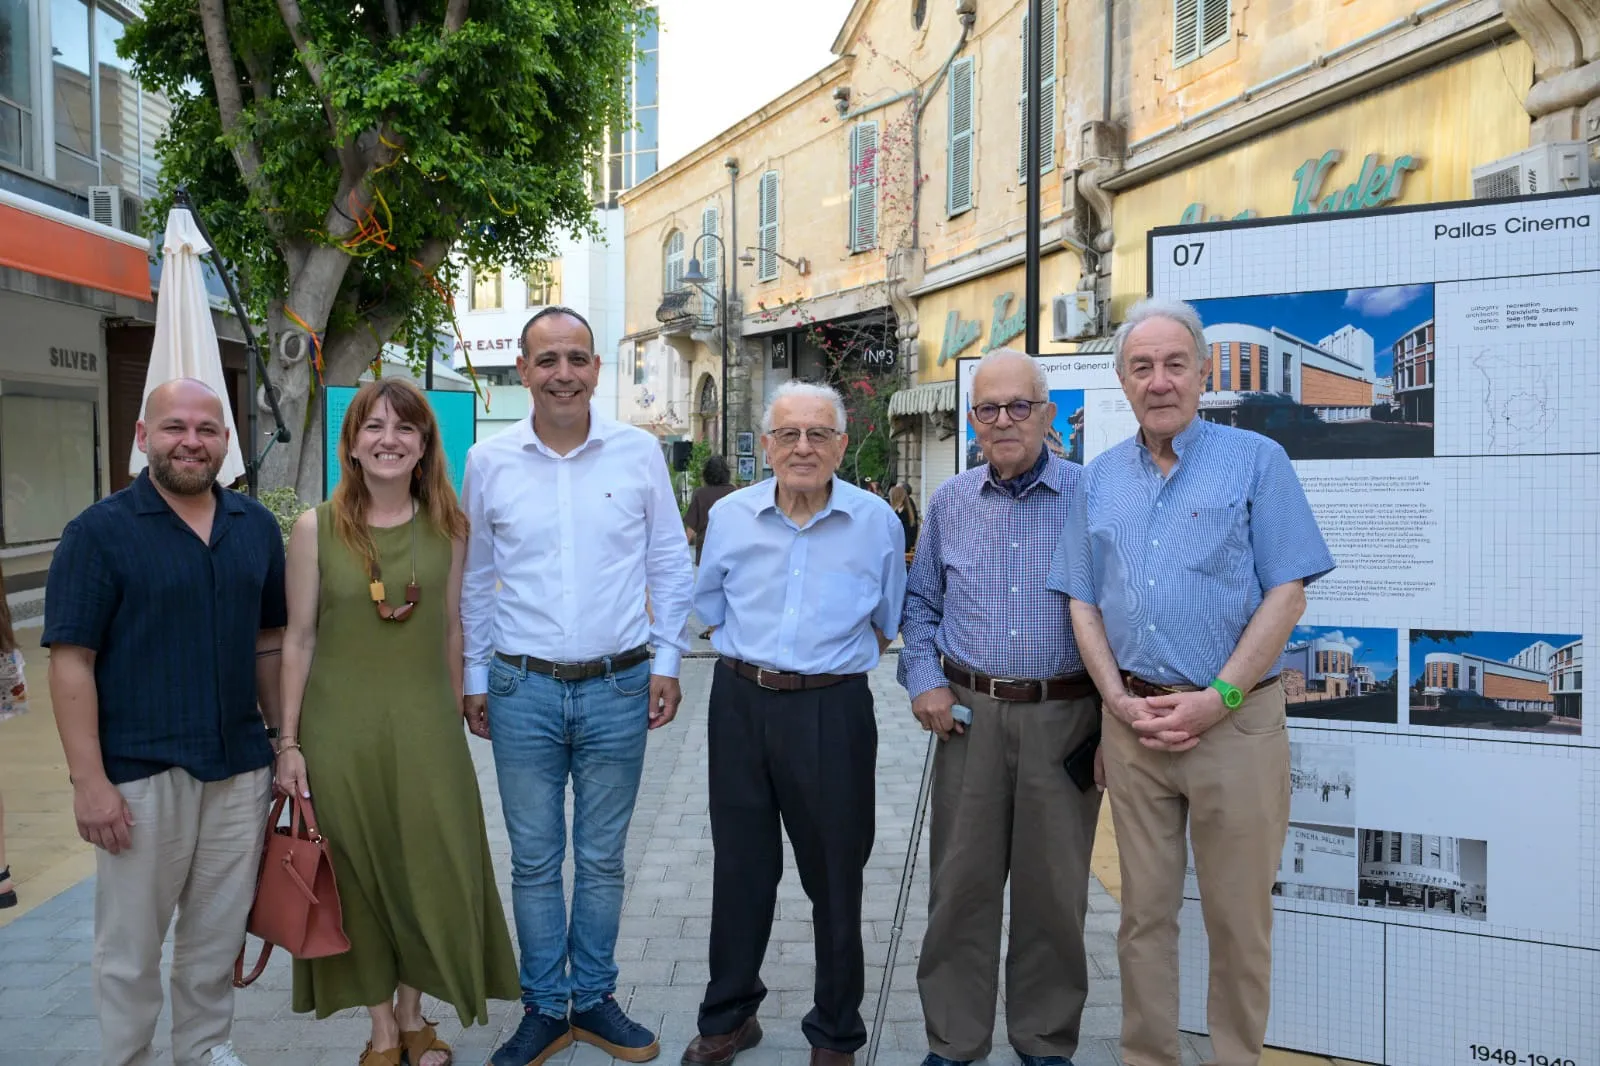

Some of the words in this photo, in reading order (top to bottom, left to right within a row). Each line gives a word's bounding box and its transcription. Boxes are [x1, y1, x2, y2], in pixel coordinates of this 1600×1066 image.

[1434, 221, 1497, 240] Pallas
[1505, 215, 1590, 234] Cinema
[1173, 242, 1205, 267] 07
[477, 338, 512, 351] EAST
[50, 347, 97, 372] SILVER
[1074, 363, 1110, 371] General
